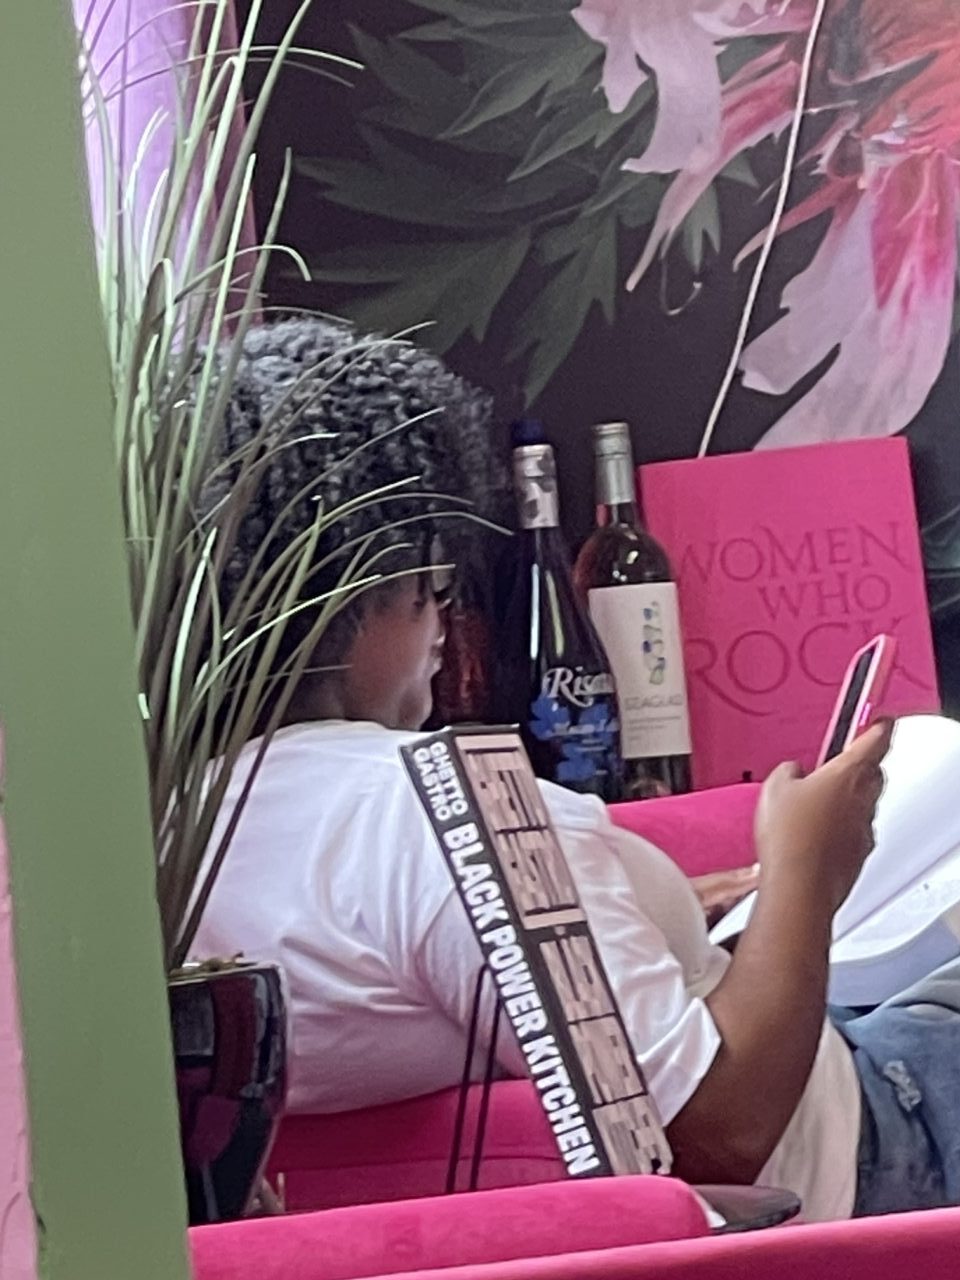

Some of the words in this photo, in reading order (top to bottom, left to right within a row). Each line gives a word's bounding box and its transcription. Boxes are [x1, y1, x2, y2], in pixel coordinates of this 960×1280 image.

[678, 521, 916, 584] WOMEN
[757, 571, 891, 621] WHO
[413, 747, 452, 821] GASTRO
[429, 741, 469, 815] GHETTO
[443, 822, 510, 930] BLACK
[480, 924, 548, 1039] POWER
[522, 1035, 600, 1176] KITCHEN
